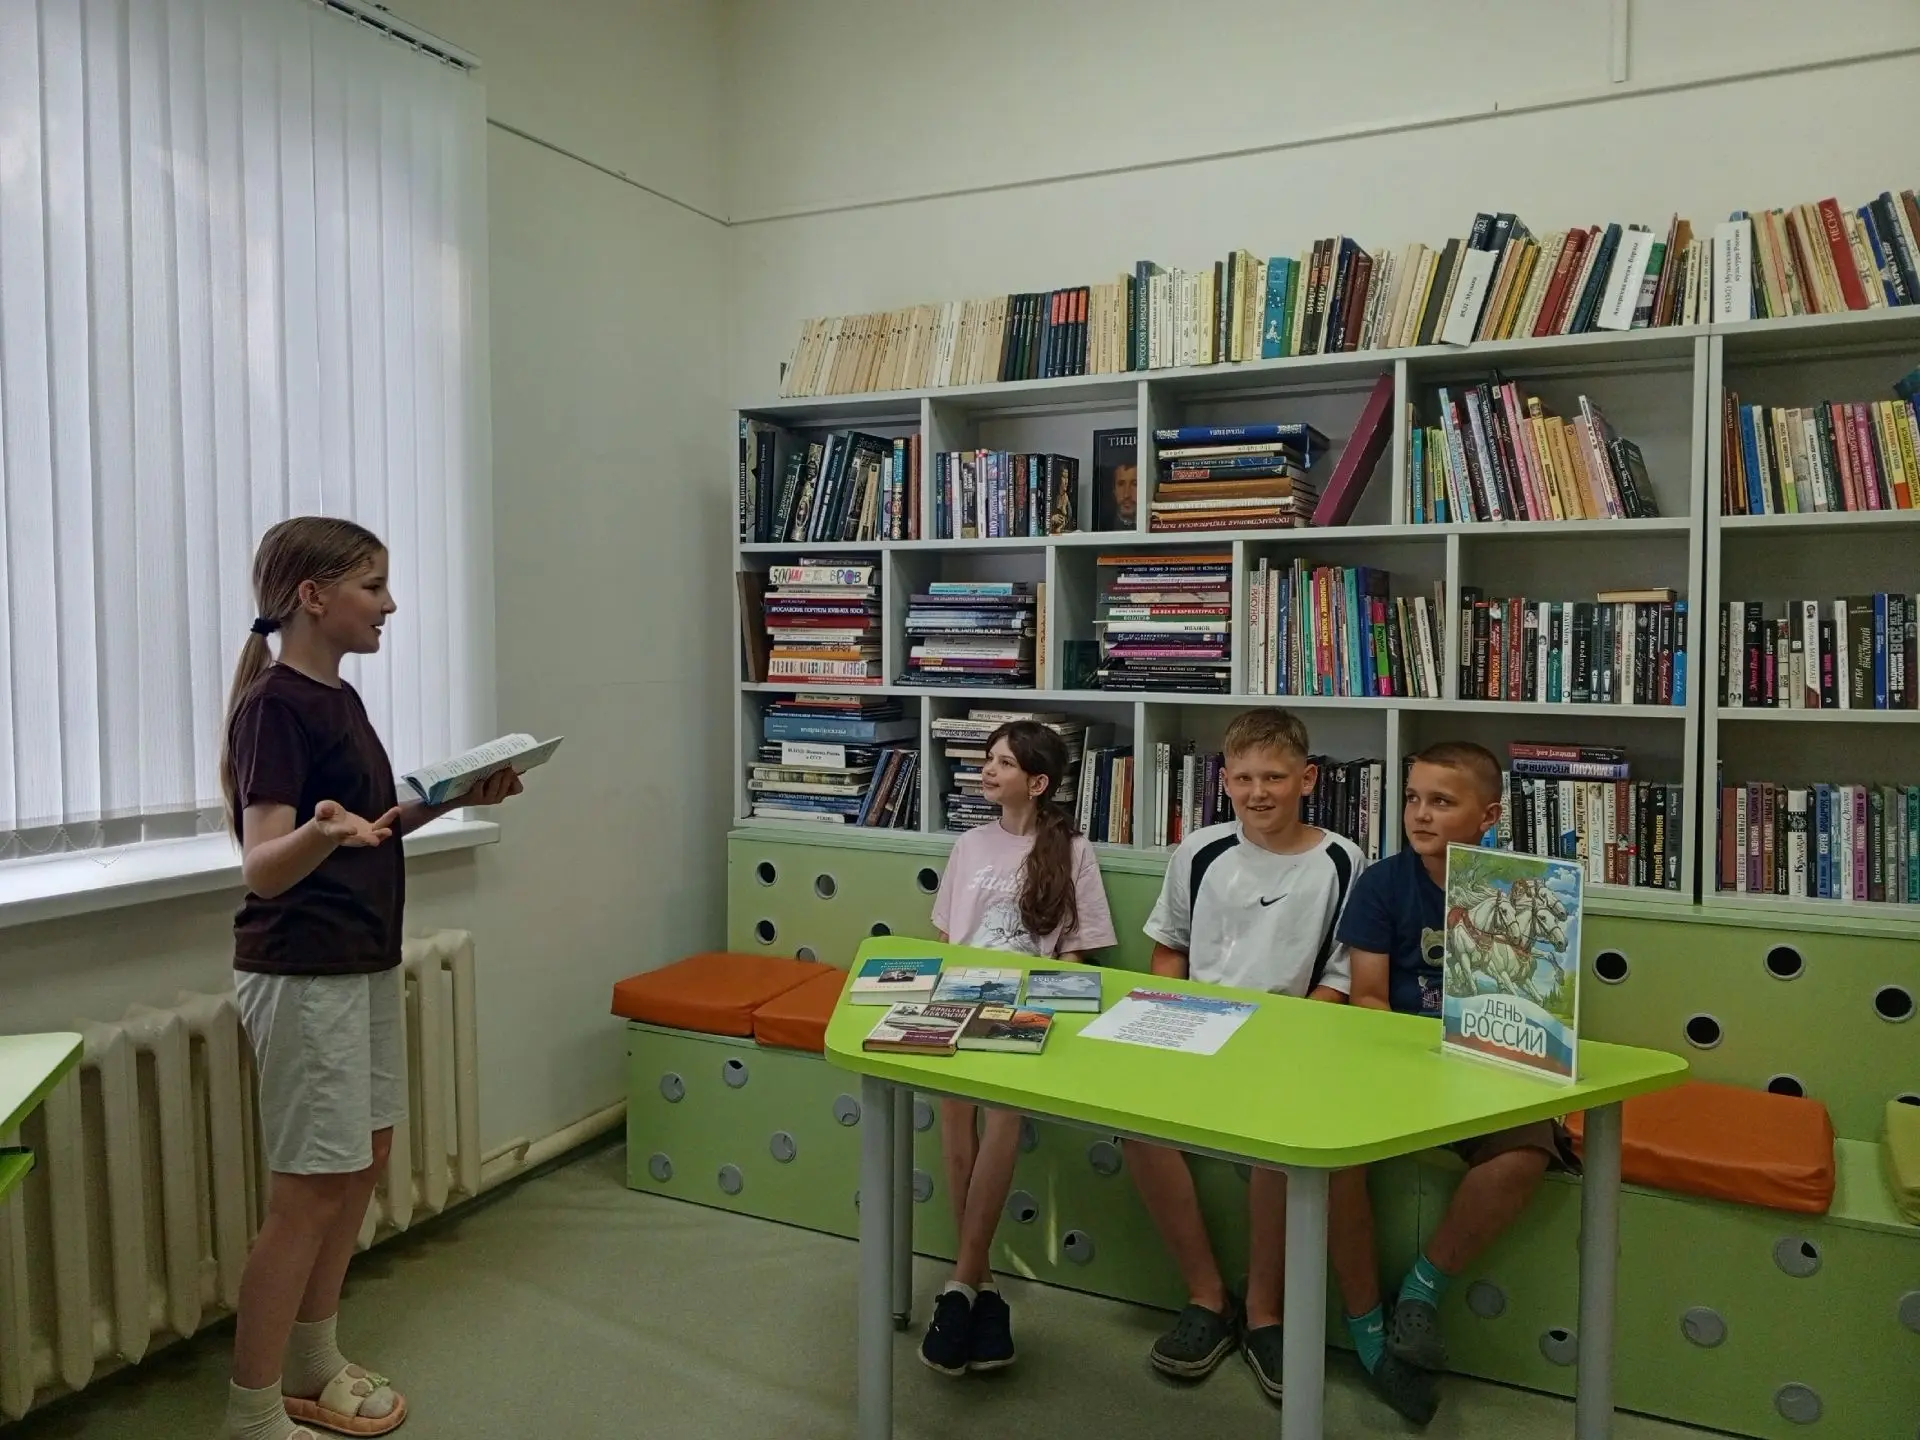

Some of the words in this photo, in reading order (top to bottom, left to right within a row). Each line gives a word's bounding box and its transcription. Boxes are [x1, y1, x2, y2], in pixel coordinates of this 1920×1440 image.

[1823, 206, 1842, 242] ПЕСНИ
[1140, 285, 1149, 330] ЖИВОПИСЬ
[1139, 331, 1148, 366] РУССКАЯ
[1250, 588, 1259, 626] РИСУНОК
[1319, 577, 1328, 613] ЖИВОПИСЬ
[1320, 619, 1328, 646] РИСУНОК
[1860, 627, 1871, 669] ВЫСОЦКИЙ
[1890, 653, 1898, 690] ВЛАДИМИР
[1652, 814, 1663, 853] Миронов
[1652, 854, 1664, 886] Андрей
[1484, 998, 1523, 1024] ДЕНЬ
[1464, 1012, 1545, 1054] РОССИИ
